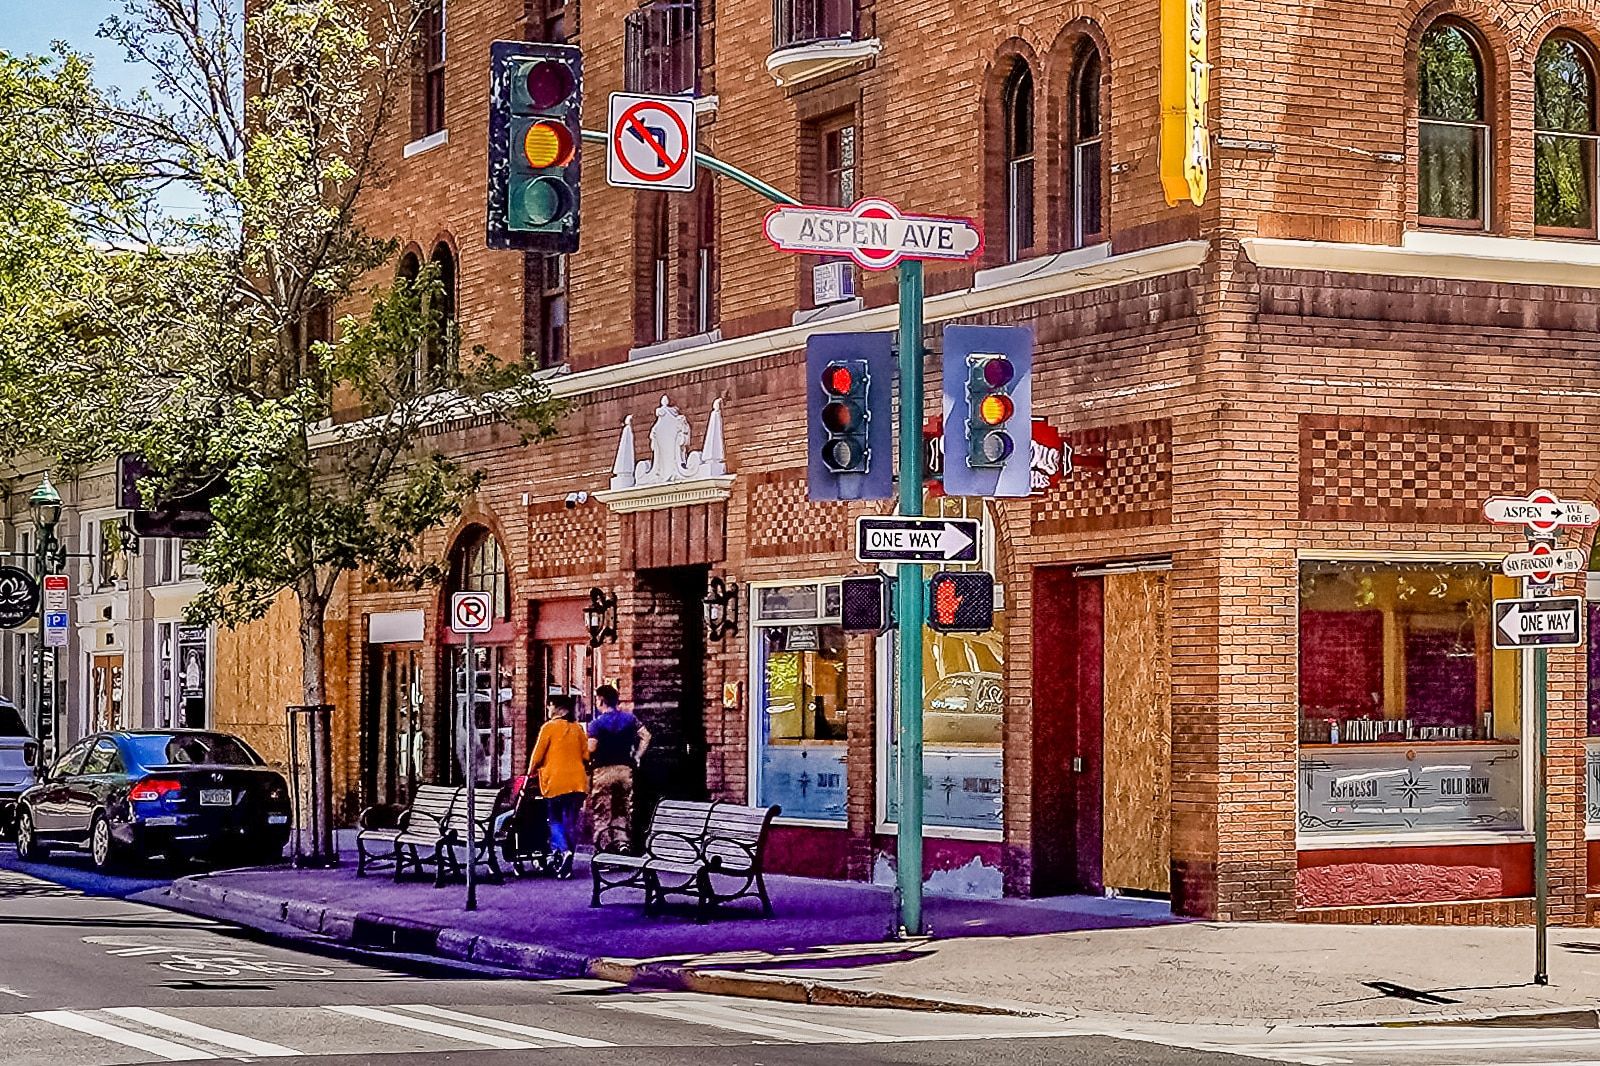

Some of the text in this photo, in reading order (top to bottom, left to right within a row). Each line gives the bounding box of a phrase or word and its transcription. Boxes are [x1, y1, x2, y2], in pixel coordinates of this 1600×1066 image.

[798, 217, 954, 250] ASPEN AVE
[1503, 506, 1543, 518] ASPEN
[1565, 504, 1583, 514] AVE
[871, 531, 942, 548] ONE WAY
[1520, 613, 1571, 632] ONE WAY
[1330, 779, 1378, 798] ESPRESSO
[1440, 777, 1490, 796] COLD BREW
